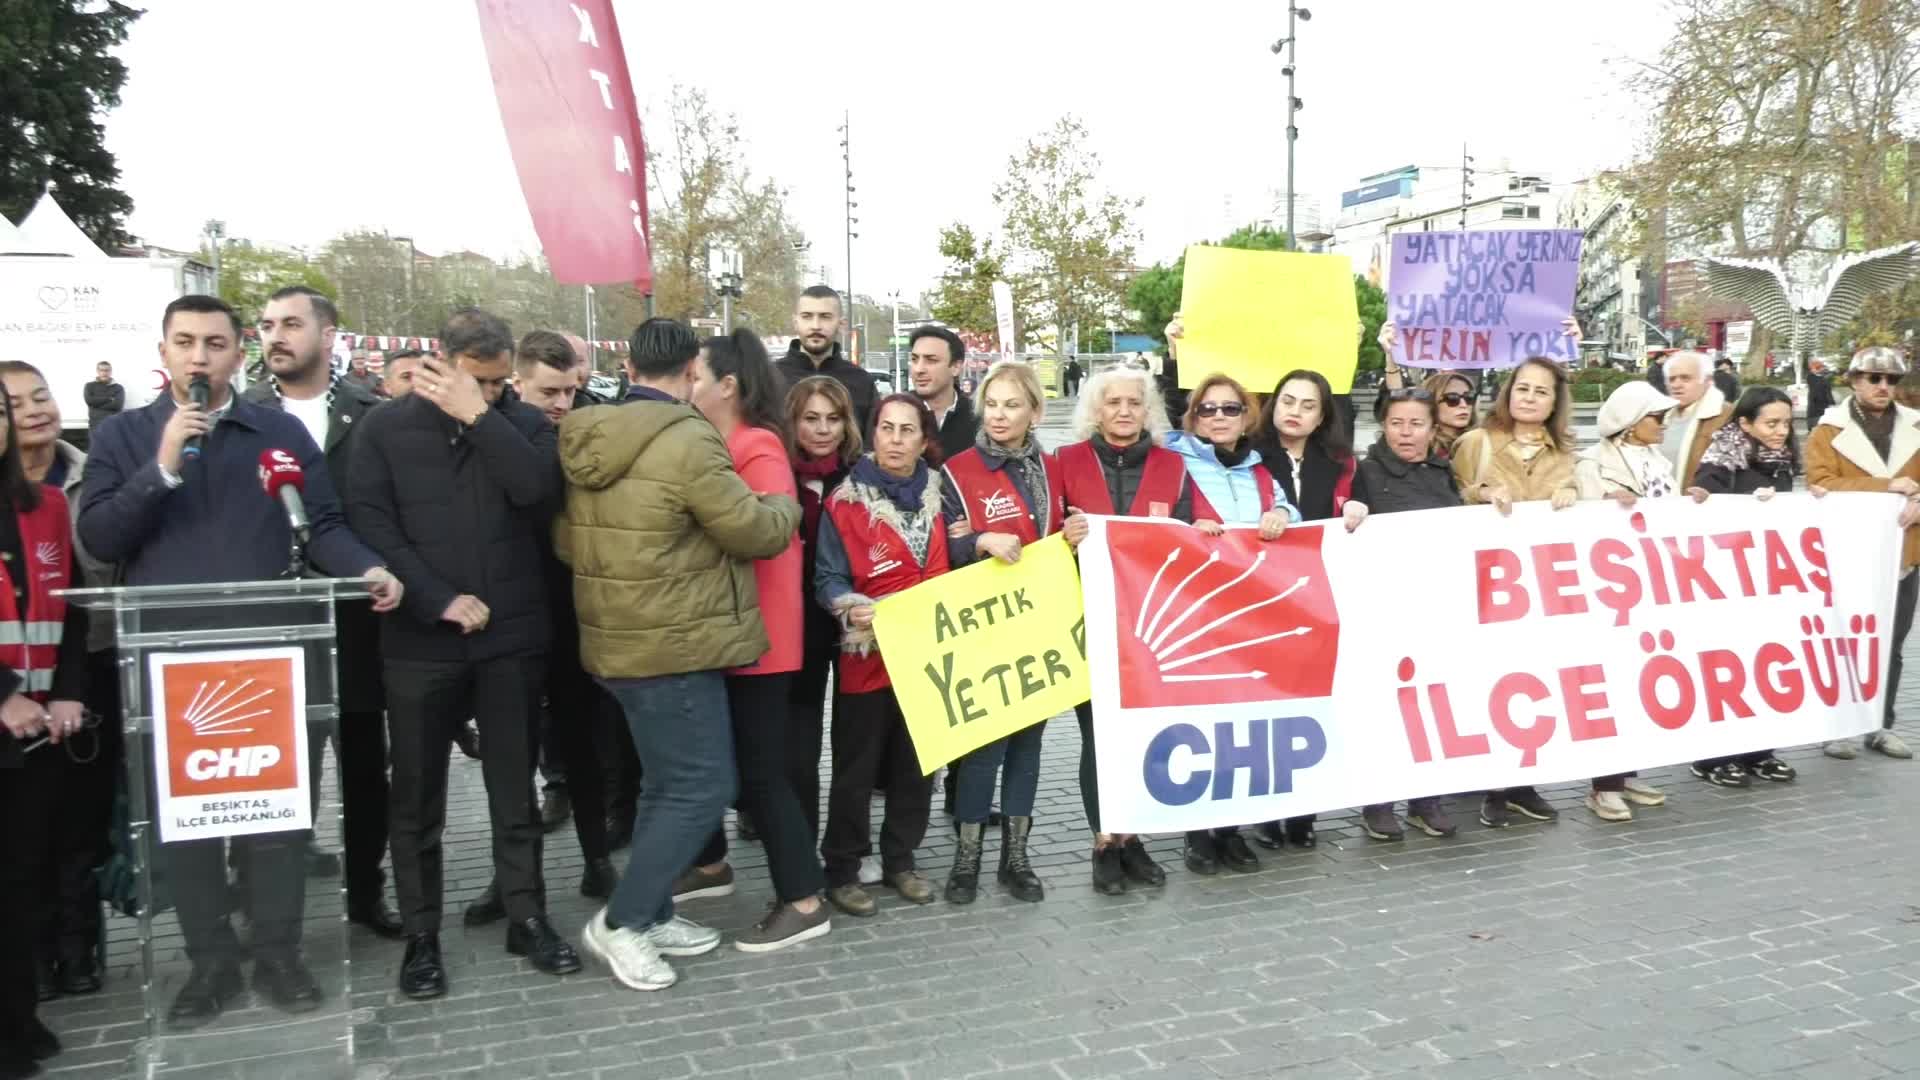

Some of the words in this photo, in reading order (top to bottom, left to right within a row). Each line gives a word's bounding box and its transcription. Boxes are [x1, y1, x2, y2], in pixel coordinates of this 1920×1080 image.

[1474, 512, 1832, 626] BEŞİKTAŞ
[935, 588, 1034, 643] ARTIK
[1397, 656, 1618, 768] İLÇE
[1639, 614, 1879, 730] ÖRGÜTÜ
[185, 745, 280, 780] CHP
[1143, 716, 1327, 806] CHP
[176, 816, 207, 828] İLÇE
[202, 799, 270, 812] BEŞİKTAŞ
